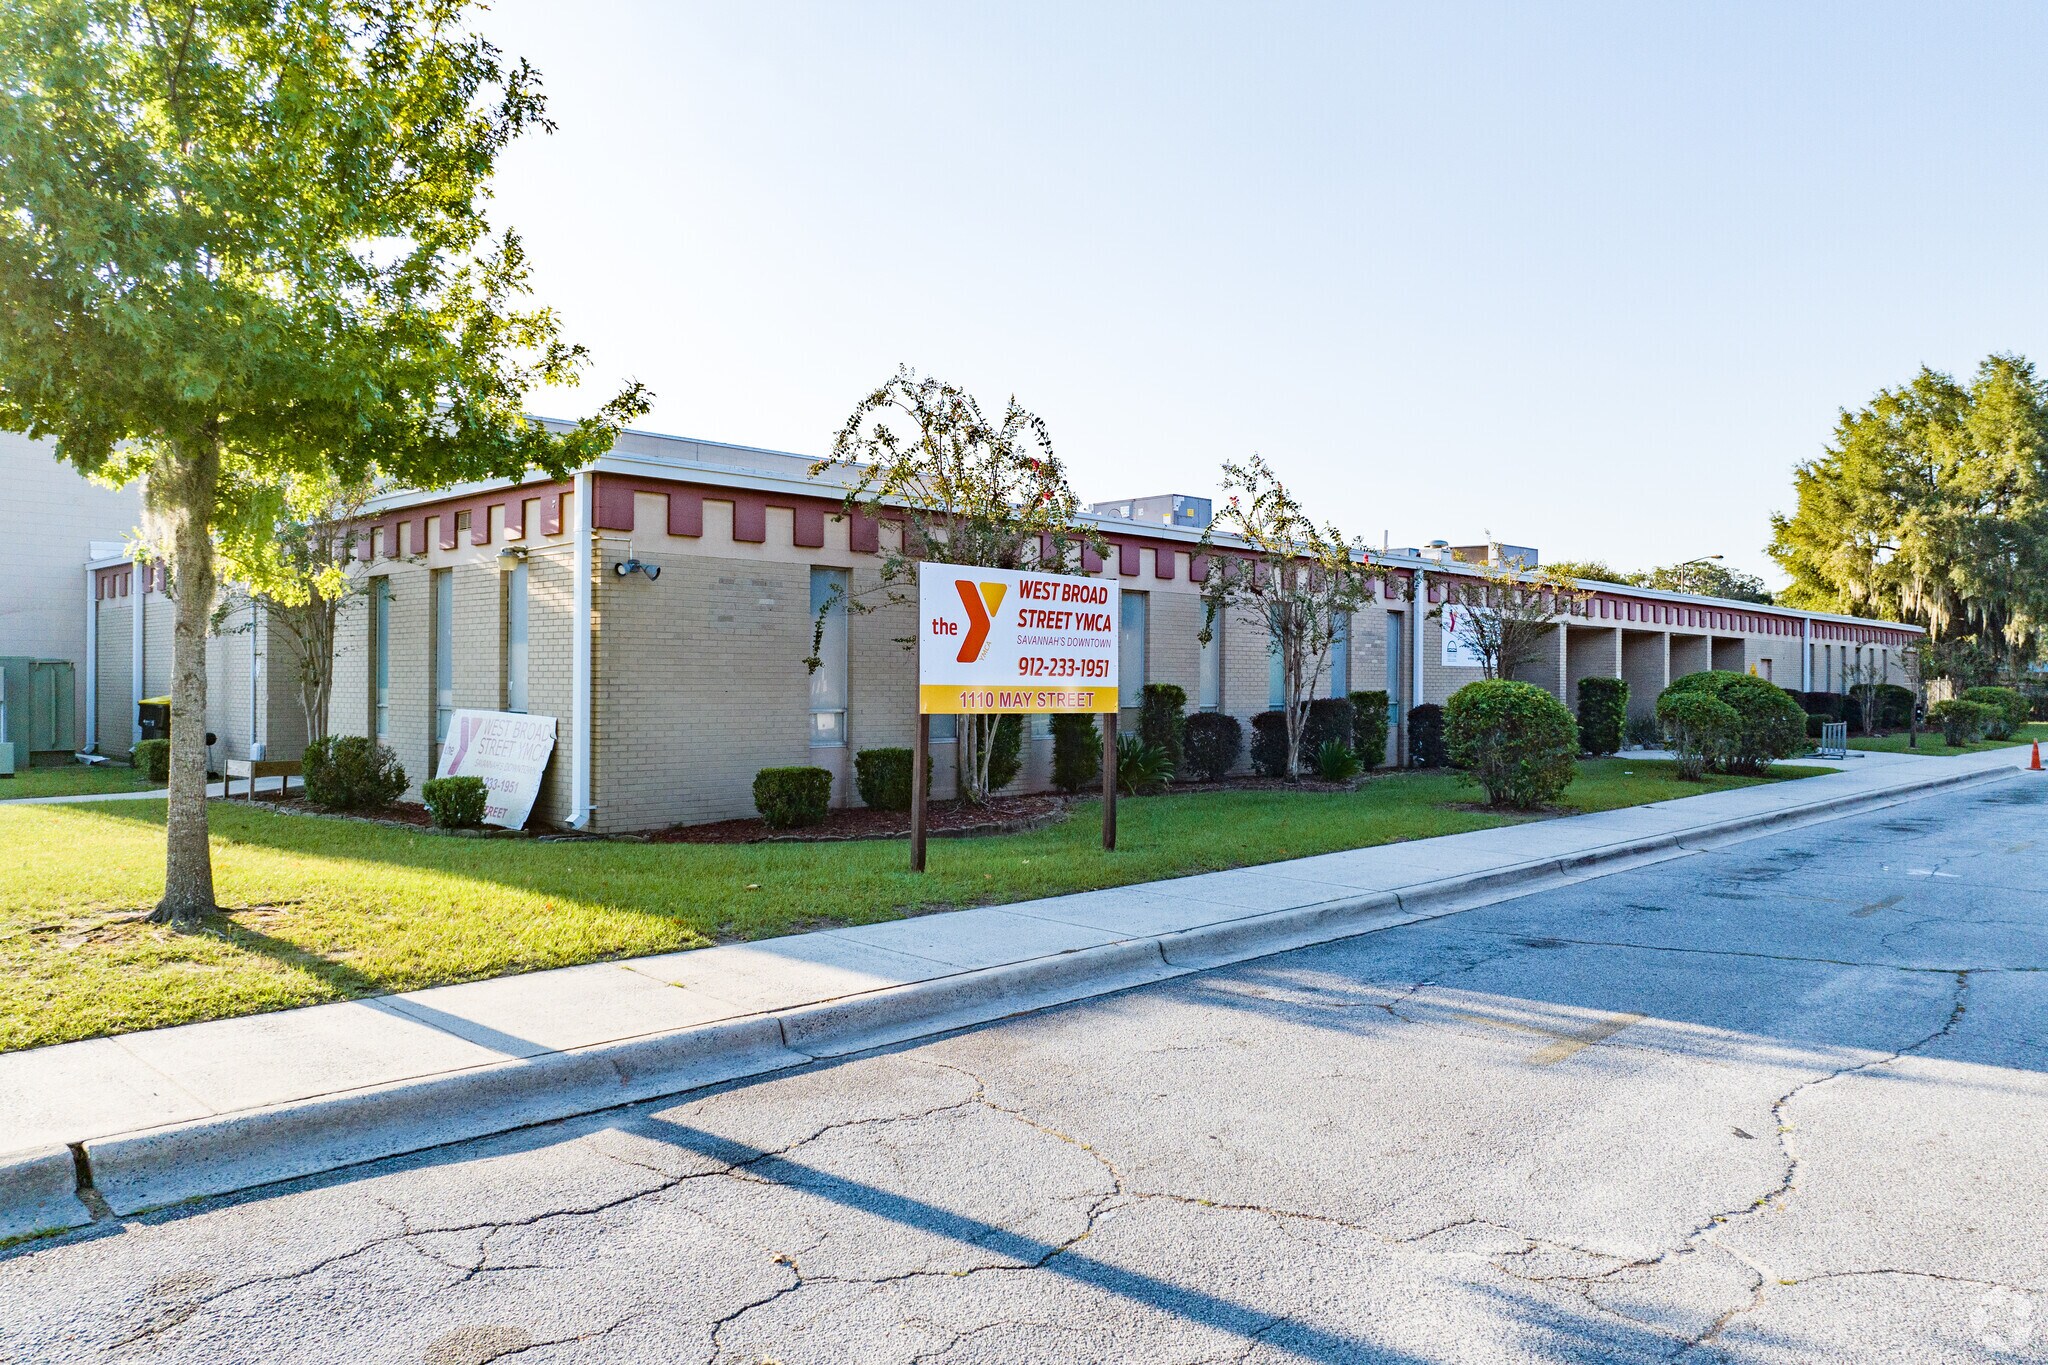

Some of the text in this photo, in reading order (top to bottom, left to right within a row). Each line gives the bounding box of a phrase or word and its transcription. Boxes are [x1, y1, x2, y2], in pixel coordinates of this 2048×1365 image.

[1019, 579, 1108, 605] WEST BROAD
[932, 617, 958, 636] the
[1017, 609, 1112, 632] STREET YMCA
[979, 641, 992, 661] YMCA
[1016, 634, 1112, 648] SAVANNAH'S DOWNTOWN
[1019, 657, 1109, 677] 912-233-1951
[959, 691, 1095, 708] 1110 MAY STREET
[483, 719, 551, 742] WEST BROAD
[478, 738, 547, 762] STREET YMCA
